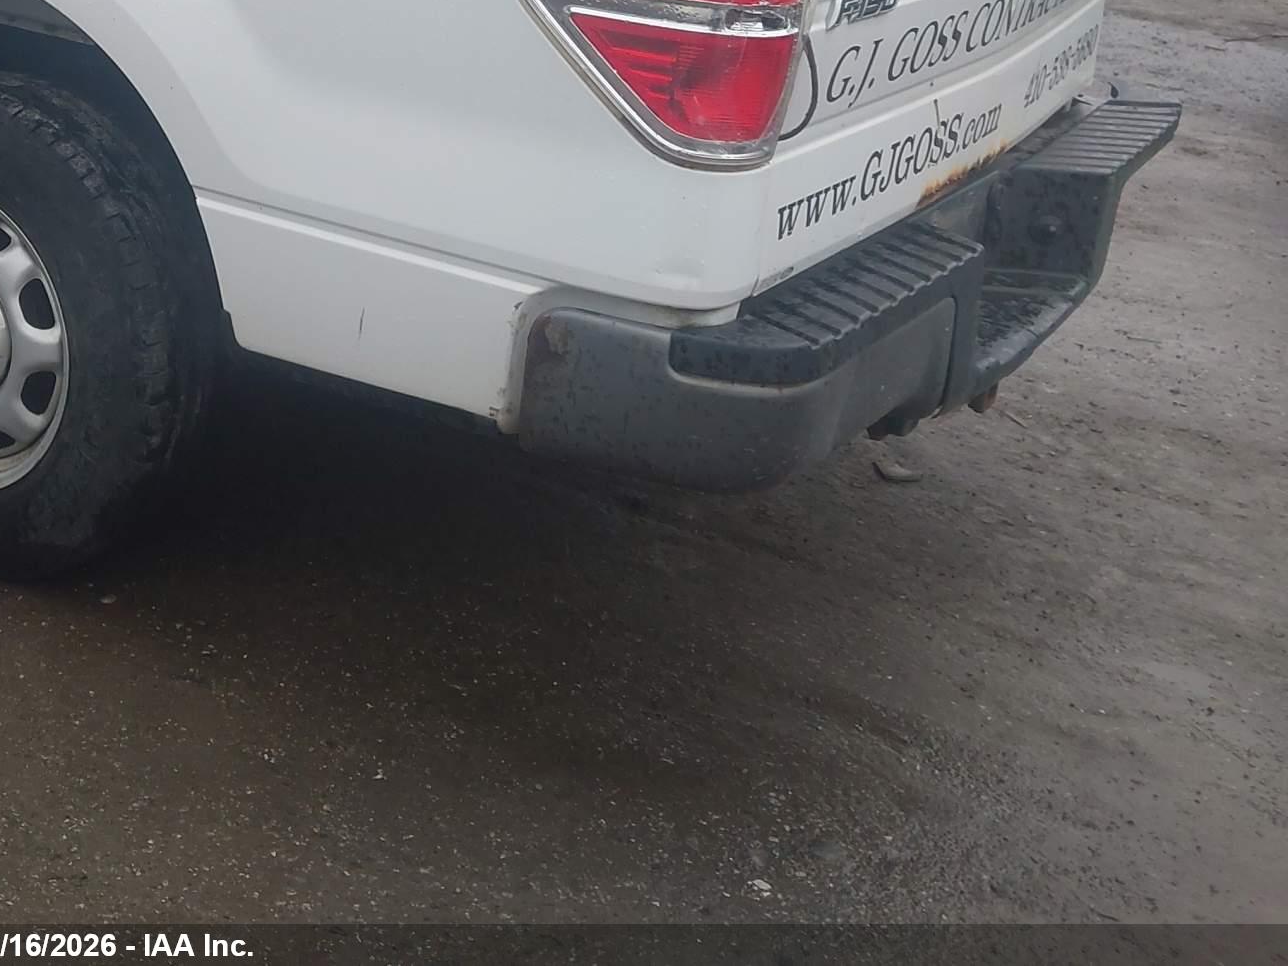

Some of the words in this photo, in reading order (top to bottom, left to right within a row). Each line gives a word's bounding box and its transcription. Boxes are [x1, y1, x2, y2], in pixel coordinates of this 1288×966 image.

[826, 38, 886, 109] G.J.
[887, 9, 969, 84] GOSS
[777, 103, 1003, 240] www.GJGOSS.com
